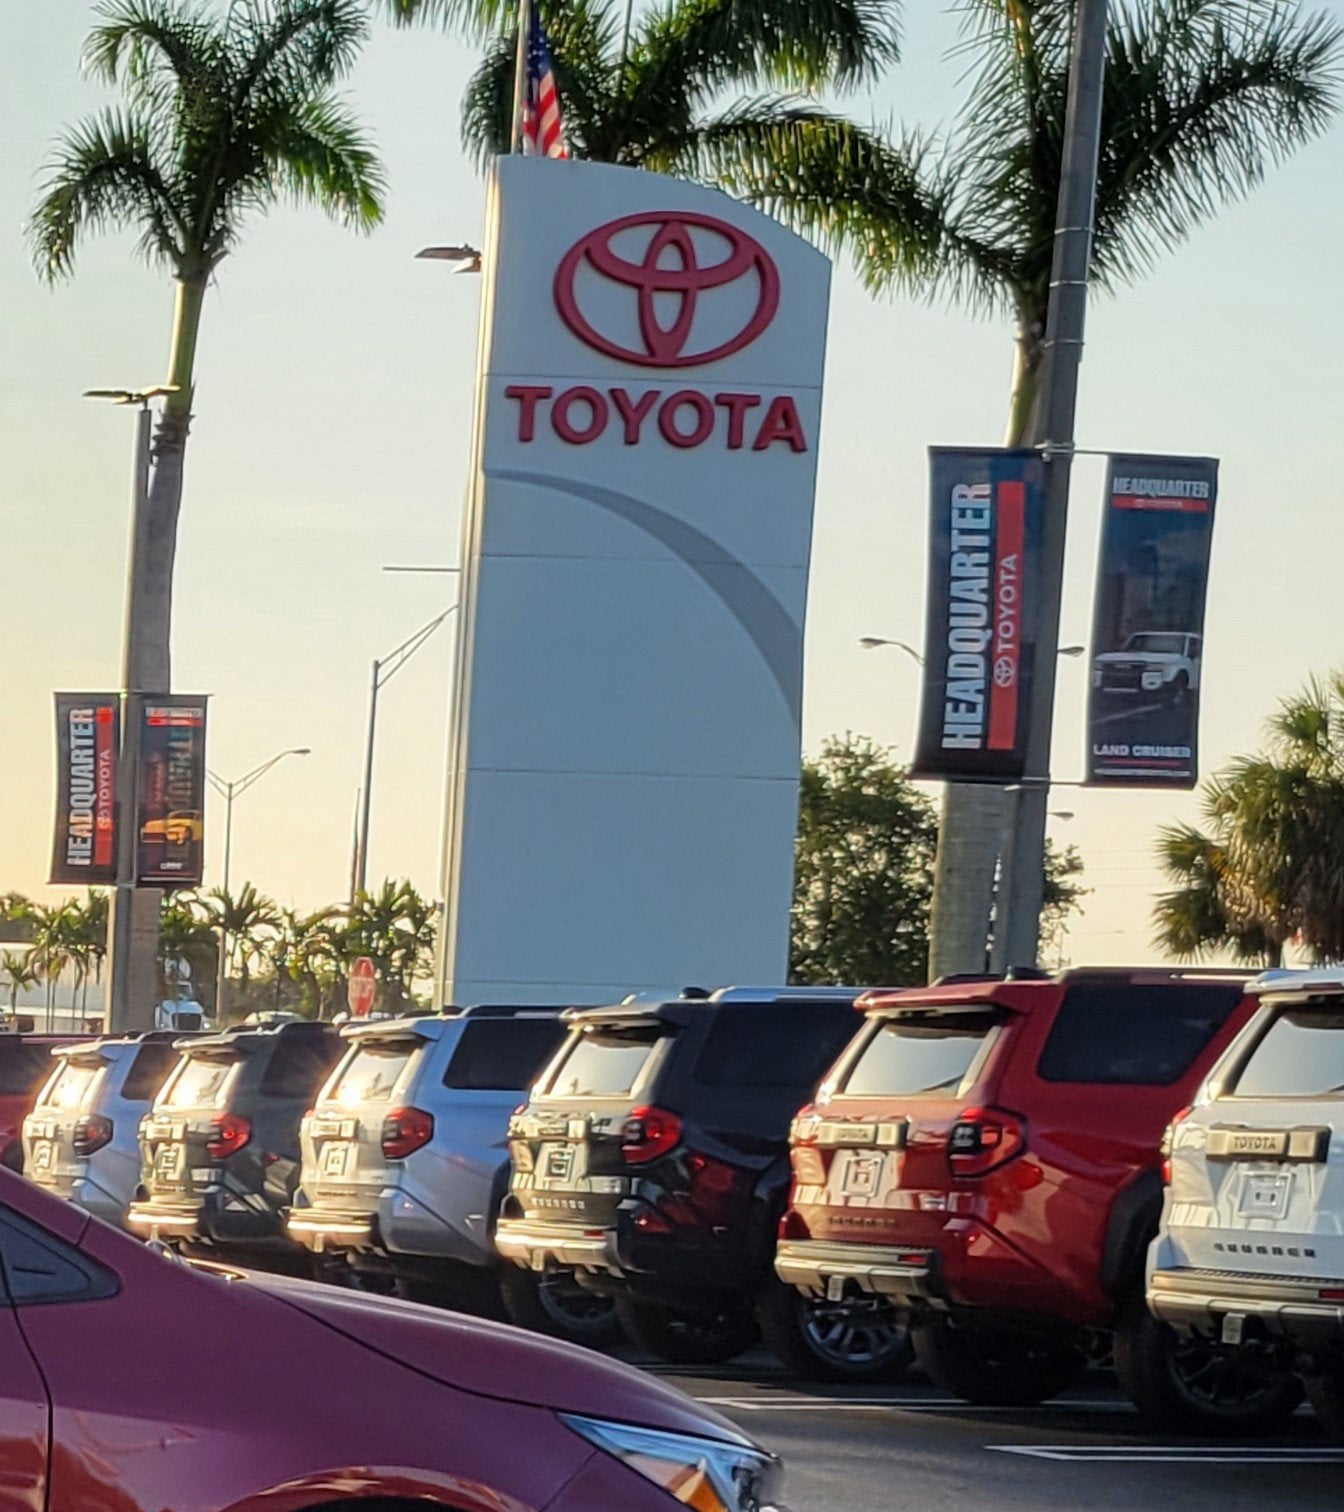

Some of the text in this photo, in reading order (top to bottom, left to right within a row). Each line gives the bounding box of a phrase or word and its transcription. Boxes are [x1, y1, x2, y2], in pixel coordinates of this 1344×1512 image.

[505, 385, 808, 453] TOYOTA
[941, 483, 992, 750] HEADQUARTER
[998, 554, 1018, 653] TOYOTA
[99, 749, 111, 810] TOYOTA
[1093, 743, 1130, 756] LAND
[66, 708, 97, 866] HEADQUARTER
[1233, 1136, 1277, 1150] TOYOTA
